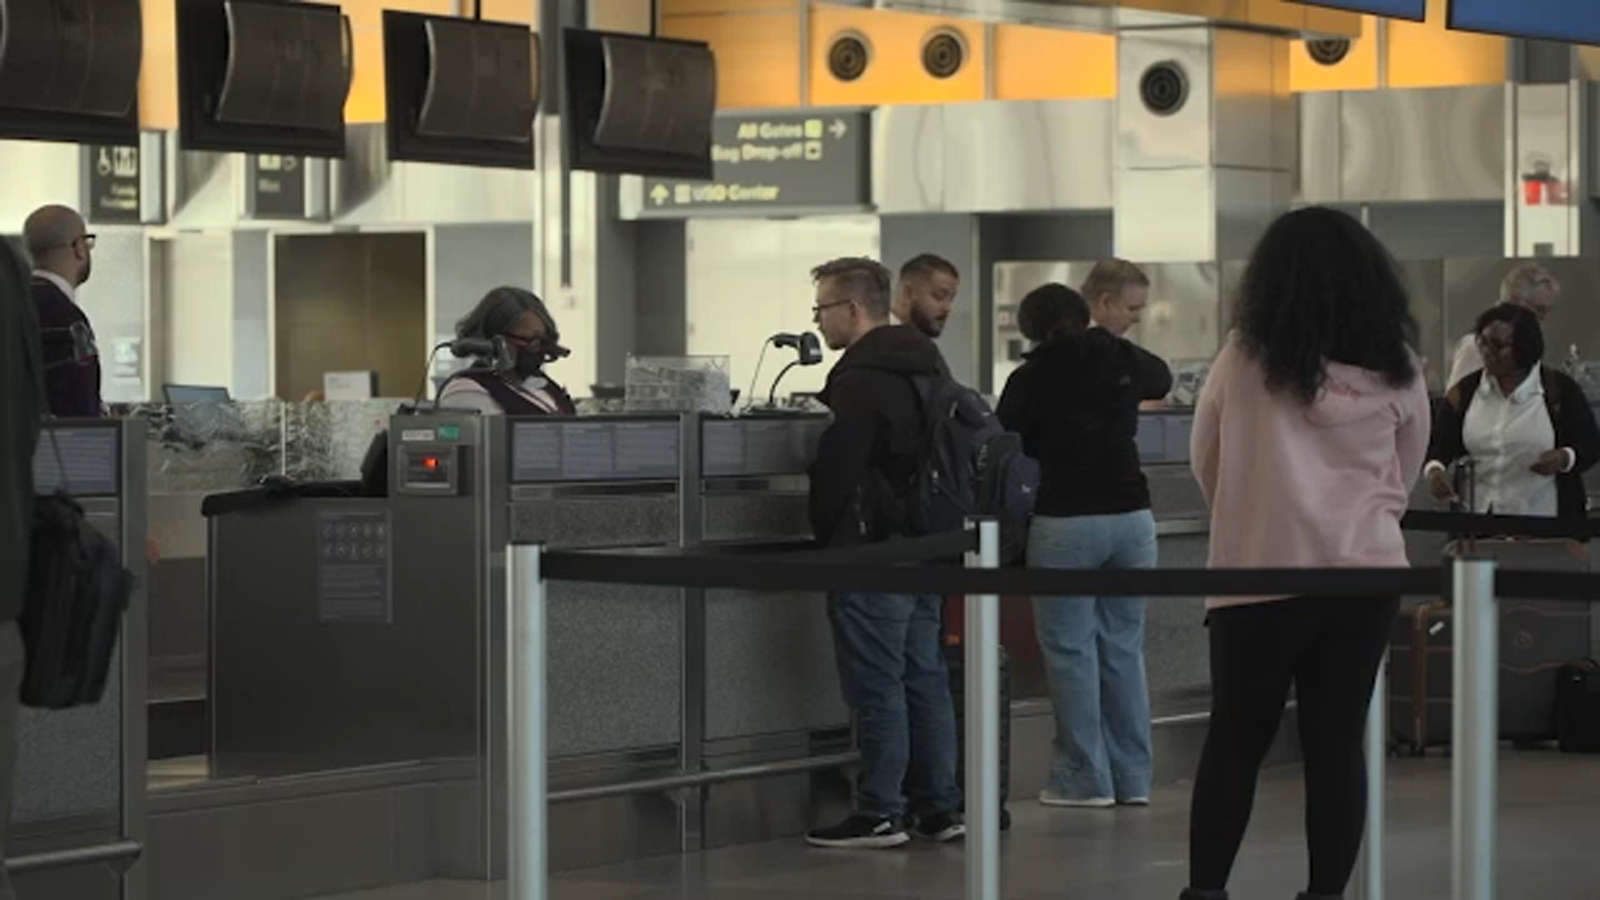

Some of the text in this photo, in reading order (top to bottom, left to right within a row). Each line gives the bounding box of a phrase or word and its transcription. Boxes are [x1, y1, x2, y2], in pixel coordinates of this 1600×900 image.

[737, 122, 803, 139] All Gates
[741, 142, 803, 161] Drop-off
[728, 183, 780, 201] Center
